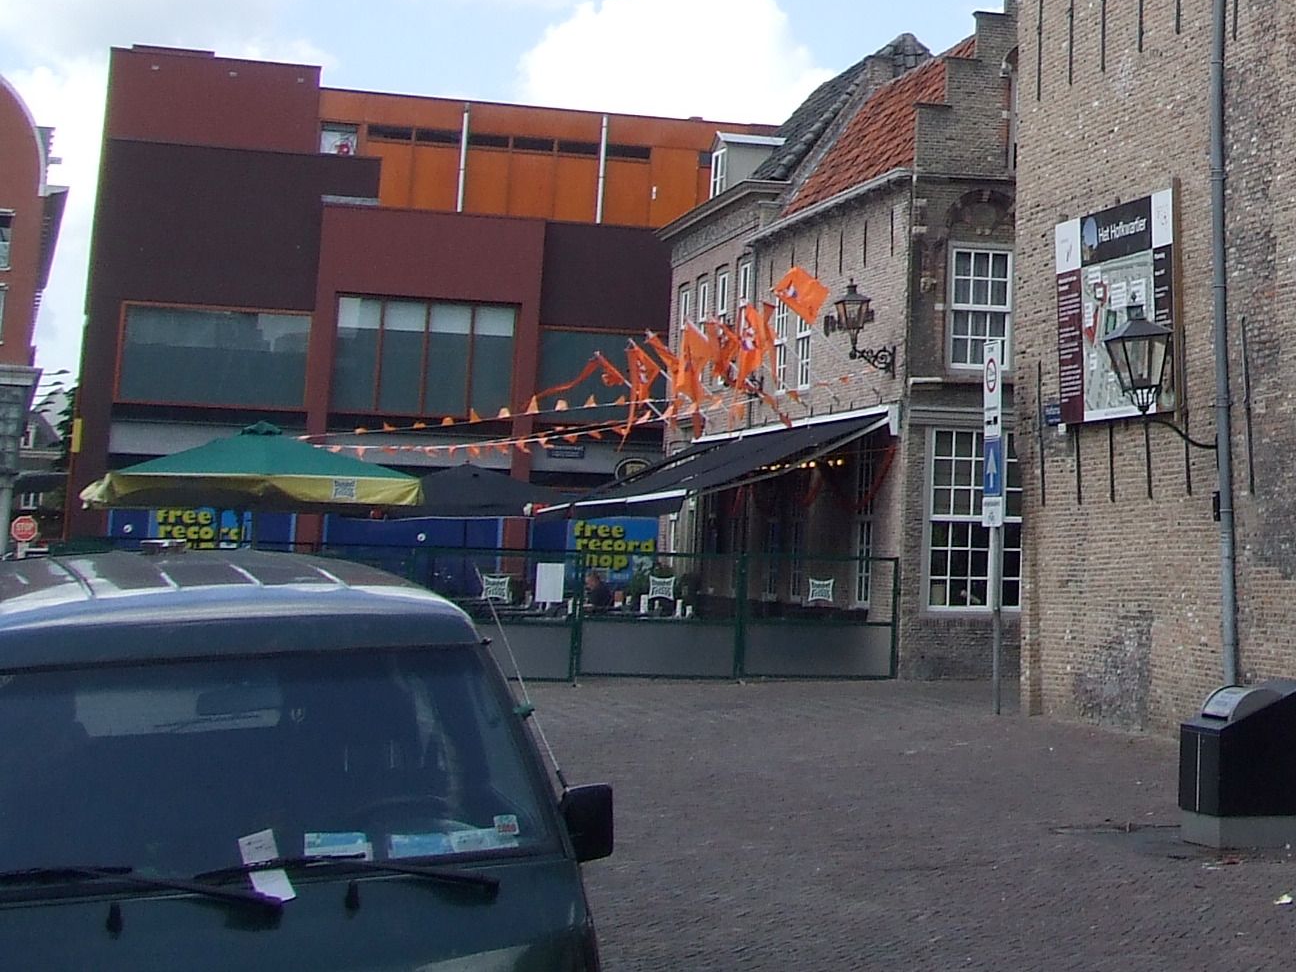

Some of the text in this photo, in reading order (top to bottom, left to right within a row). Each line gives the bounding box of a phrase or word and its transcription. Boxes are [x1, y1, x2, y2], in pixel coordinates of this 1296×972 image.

[1098, 216, 1147, 243] Het Hofkwartier
[156, 509, 212, 524] free
[15, 522, 35, 531] STOP
[574, 520, 624, 538] free
[576, 538, 655, 552] record
